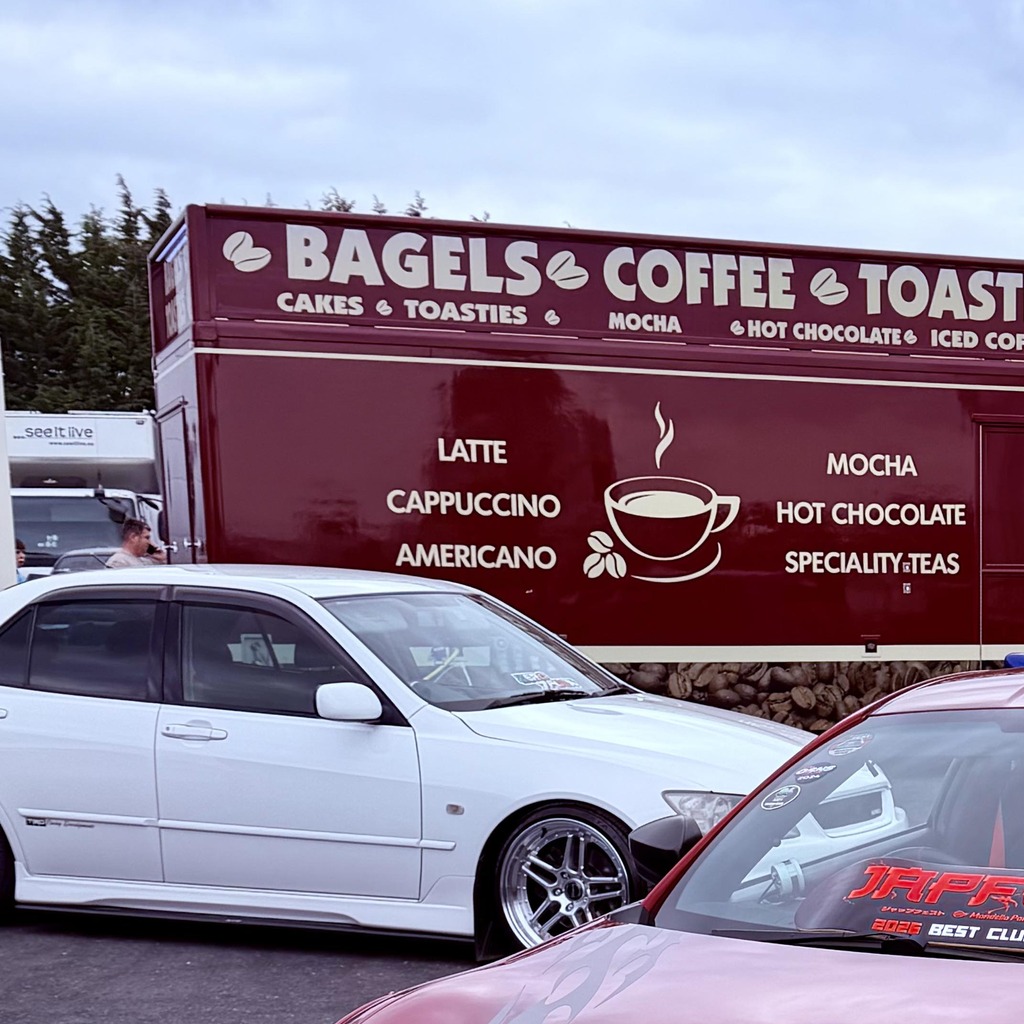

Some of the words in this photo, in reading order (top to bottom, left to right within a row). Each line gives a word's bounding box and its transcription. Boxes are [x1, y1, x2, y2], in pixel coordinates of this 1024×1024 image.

[286, 223, 542, 297] BAGELS
[603, 246, 796, 310] COFFEE
[276, 292, 364, 316] CAKES
[403, 299, 528, 325] TOASTIES
[608, 312, 683, 333] MOCHA
[747, 319, 788, 340] HOT
[793, 322, 902, 346] CHOCOLATE
[930, 328, 979, 349] ICED
[437, 437, 508, 464] LATTE
[826, 453, 918, 476] MOCHA
[386, 489, 562, 518] CAPPUCCINO
[776, 501, 825, 524] HOT
[831, 502, 967, 525] CHOCOLATE
[395, 543, 557, 570] AMERICANO
[785, 550, 904, 574] SPECIALITY
[908, 552, 960, 575] TEAS
[872, 918, 923, 935] 2026
[928, 923, 980, 938] BEST
